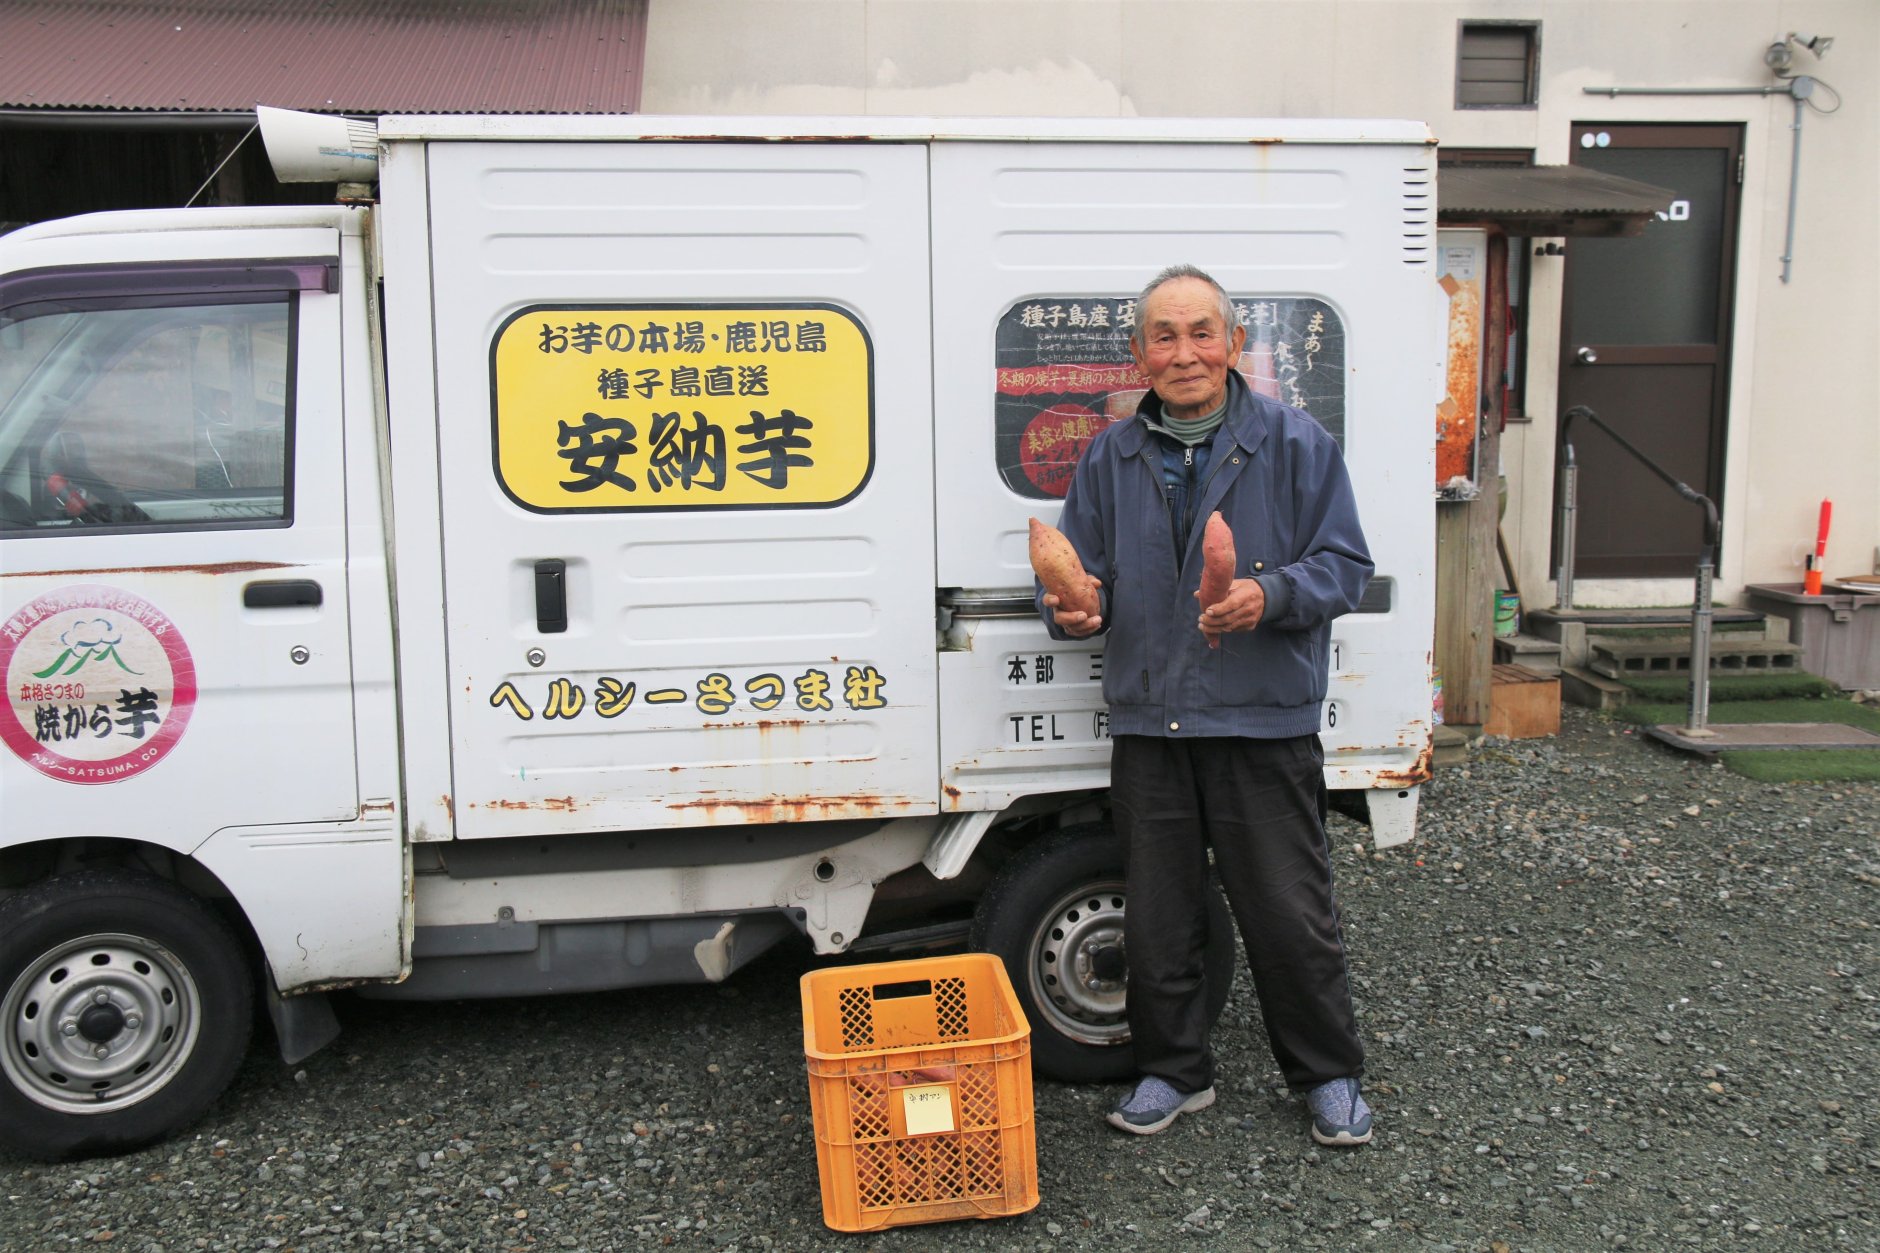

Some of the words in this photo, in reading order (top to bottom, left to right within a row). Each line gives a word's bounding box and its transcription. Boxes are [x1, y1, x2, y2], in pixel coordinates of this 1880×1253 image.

[1021, 304, 1109, 328] 種子島産
[539, 320, 827, 354] お芋の本場・鹿児島
[598, 365, 770, 400] 種子島直送
[557, 409, 814, 493] 安納芋
[1028, 415, 1099, 454] 美容と健康に
[1008, 654, 1054, 684] 本部
[20, 683, 85, 702] 本格さつまの
[490, 666, 888, 721] ヘルシーさつま社
[35, 686, 161, 743] 焼から芋
[1010, 714, 1065, 743] TEL
